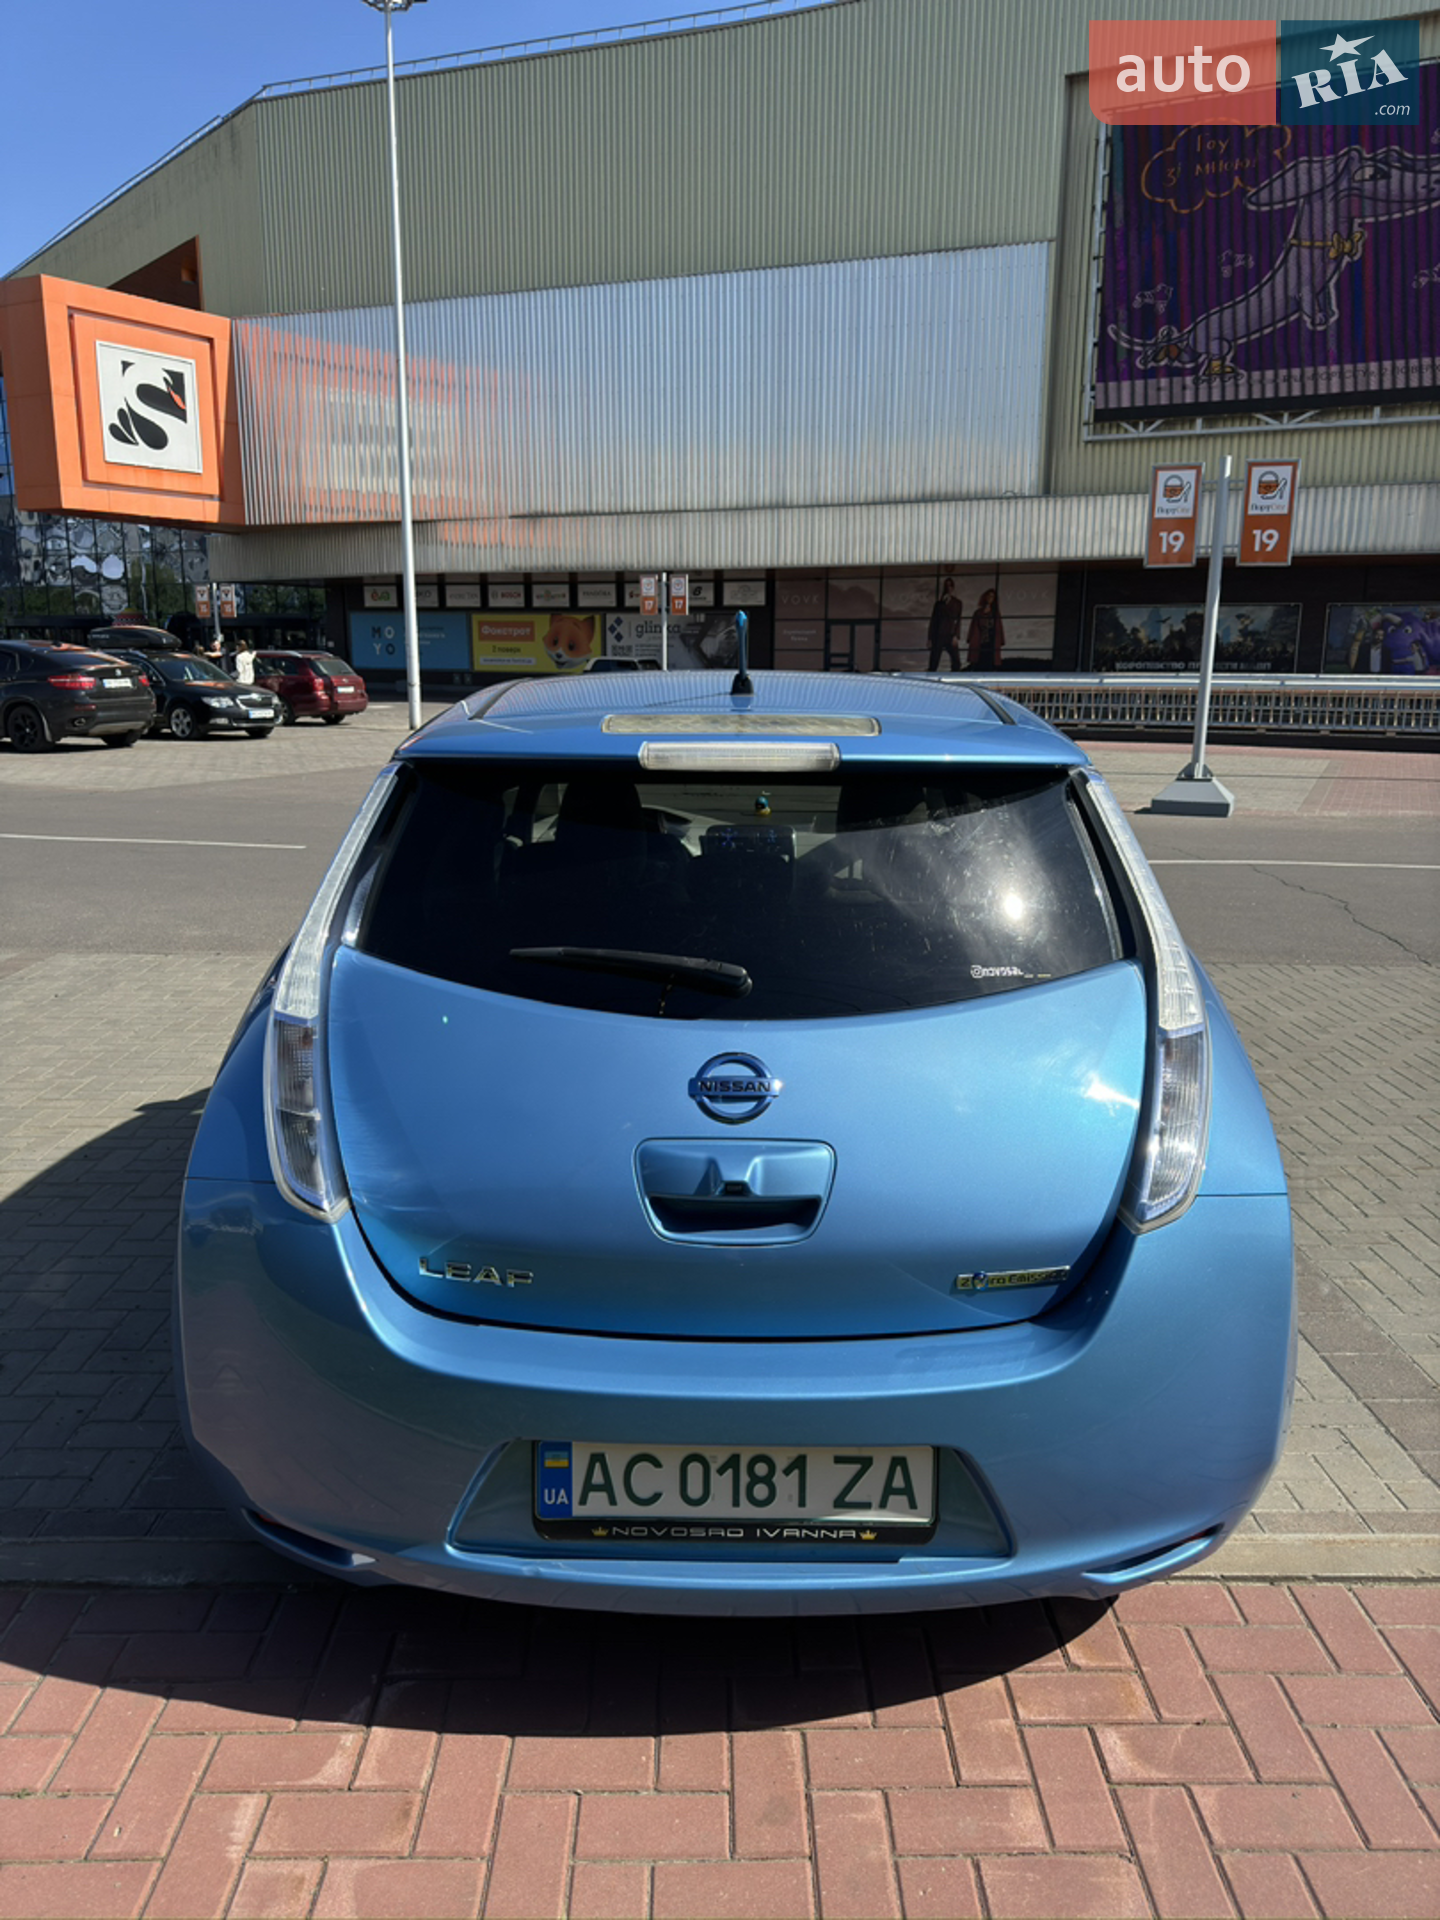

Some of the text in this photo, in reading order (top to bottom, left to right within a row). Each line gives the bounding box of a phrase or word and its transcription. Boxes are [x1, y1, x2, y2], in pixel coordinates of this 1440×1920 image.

[1158, 530, 1185, 554] 19
[1252, 528, 1280, 552] 19
[501, 590, 521, 600] BOSCH
[781, 593, 820, 606] VOVK
[1005, 588, 1050, 601] VOVK
[644, 600, 654, 611] 17
[674, 599, 684, 609] 17
[481, 625, 531, 637] Фокстрот
[698, 1080, 771, 1092] NISSAN
[418, 1256, 534, 1288] LEAF
[578, 1452, 918, 1511] AC 0181 ZA
[543, 1488, 569, 1505] UA
[612, 1526, 857, 1539] NOVOSAD IVANNA
